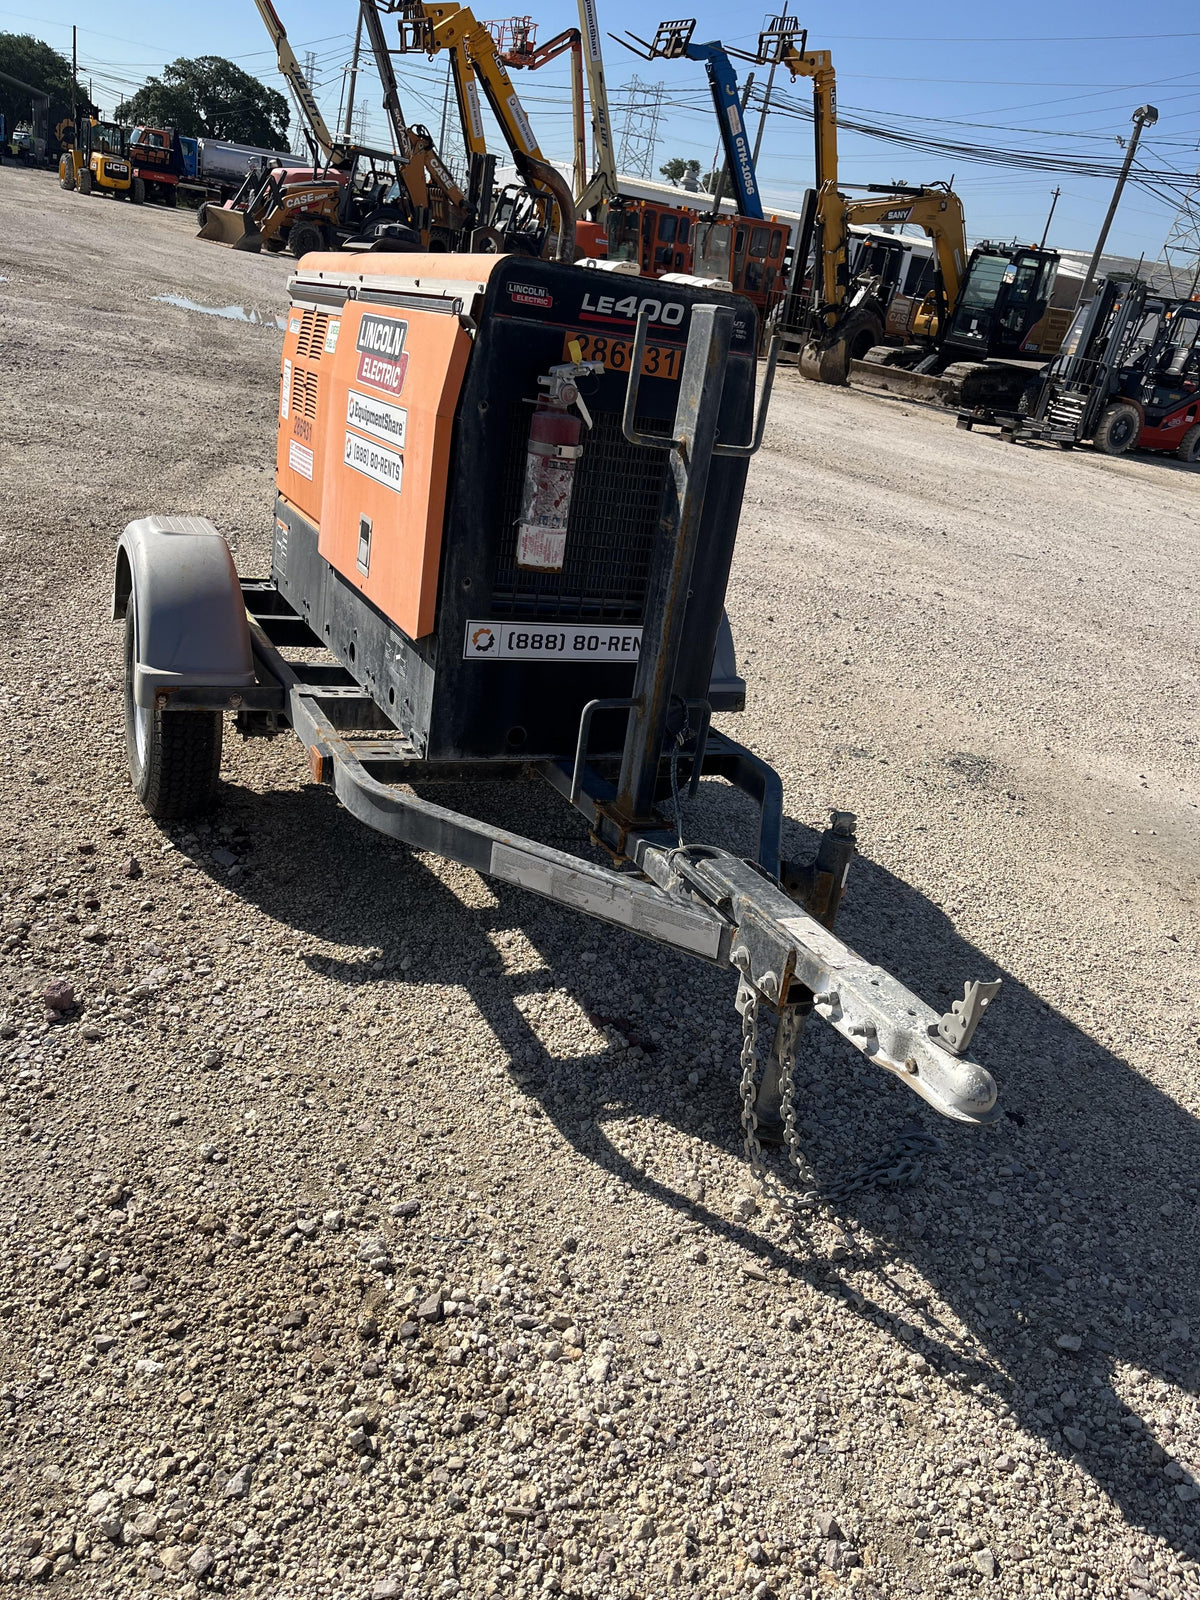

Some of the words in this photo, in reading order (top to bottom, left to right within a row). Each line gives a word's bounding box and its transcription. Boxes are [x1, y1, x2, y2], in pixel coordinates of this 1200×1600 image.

[491, 52, 506, 76] JCB
[302, 93, 320, 117] LIFT
[829, 87, 837, 114] JCB
[597, 105, 606, 124] JLG
[600, 127, 608, 149] LIFT
[106, 162, 128, 173] JCB
[430, 158, 454, 189] CASE
[735, 136, 755, 195] GTH-1056
[286, 193, 314, 208] CASE
[887, 210, 909, 220] SANY
[508, 283, 545, 297] LINCOLN
[516, 294, 549, 305] ELECTRIC
[581, 293, 685, 325] LE400
[359, 320, 404, 356] LINCOLN
[575, 334, 675, 377] 28631
[361, 357, 401, 388] ELECTRIC
[355, 401, 403, 436] EquipmentShare
[353, 443, 369, 466] (888)
[370, 452, 400, 481] 80-RENTS
[508, 632, 566, 651] (888)
